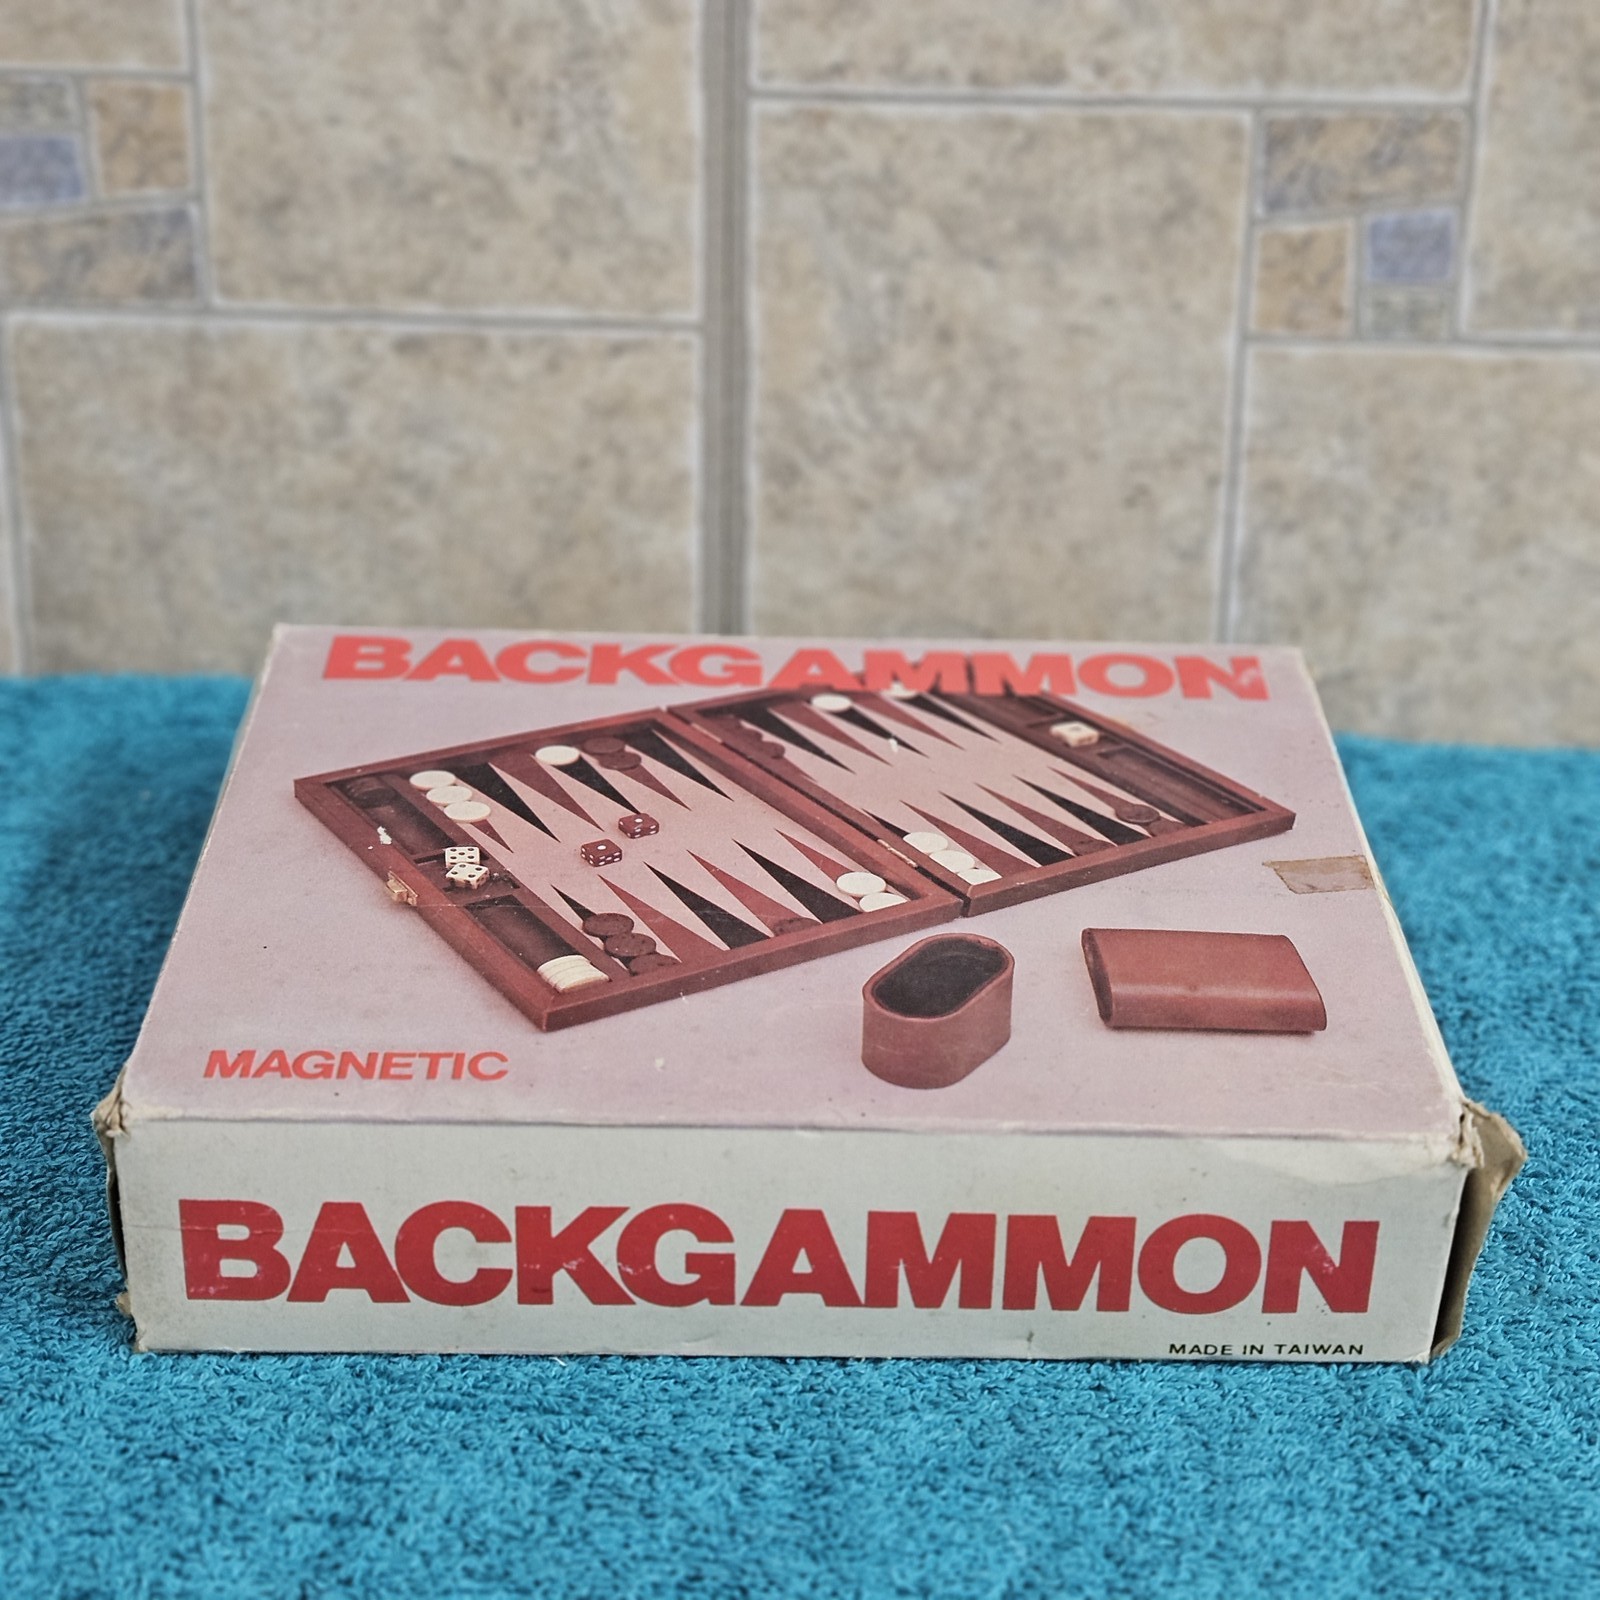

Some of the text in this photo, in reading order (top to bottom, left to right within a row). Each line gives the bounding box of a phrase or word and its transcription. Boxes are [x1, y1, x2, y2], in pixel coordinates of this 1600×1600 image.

[322, 635, 1269, 702] BACKGAMMON
[204, 1050, 509, 1081] MAGNETIC
[179, 1199, 1380, 1314] BACKGAMMON
[1168, 1343, 1364, 1356] MADE IN TAIWAN
